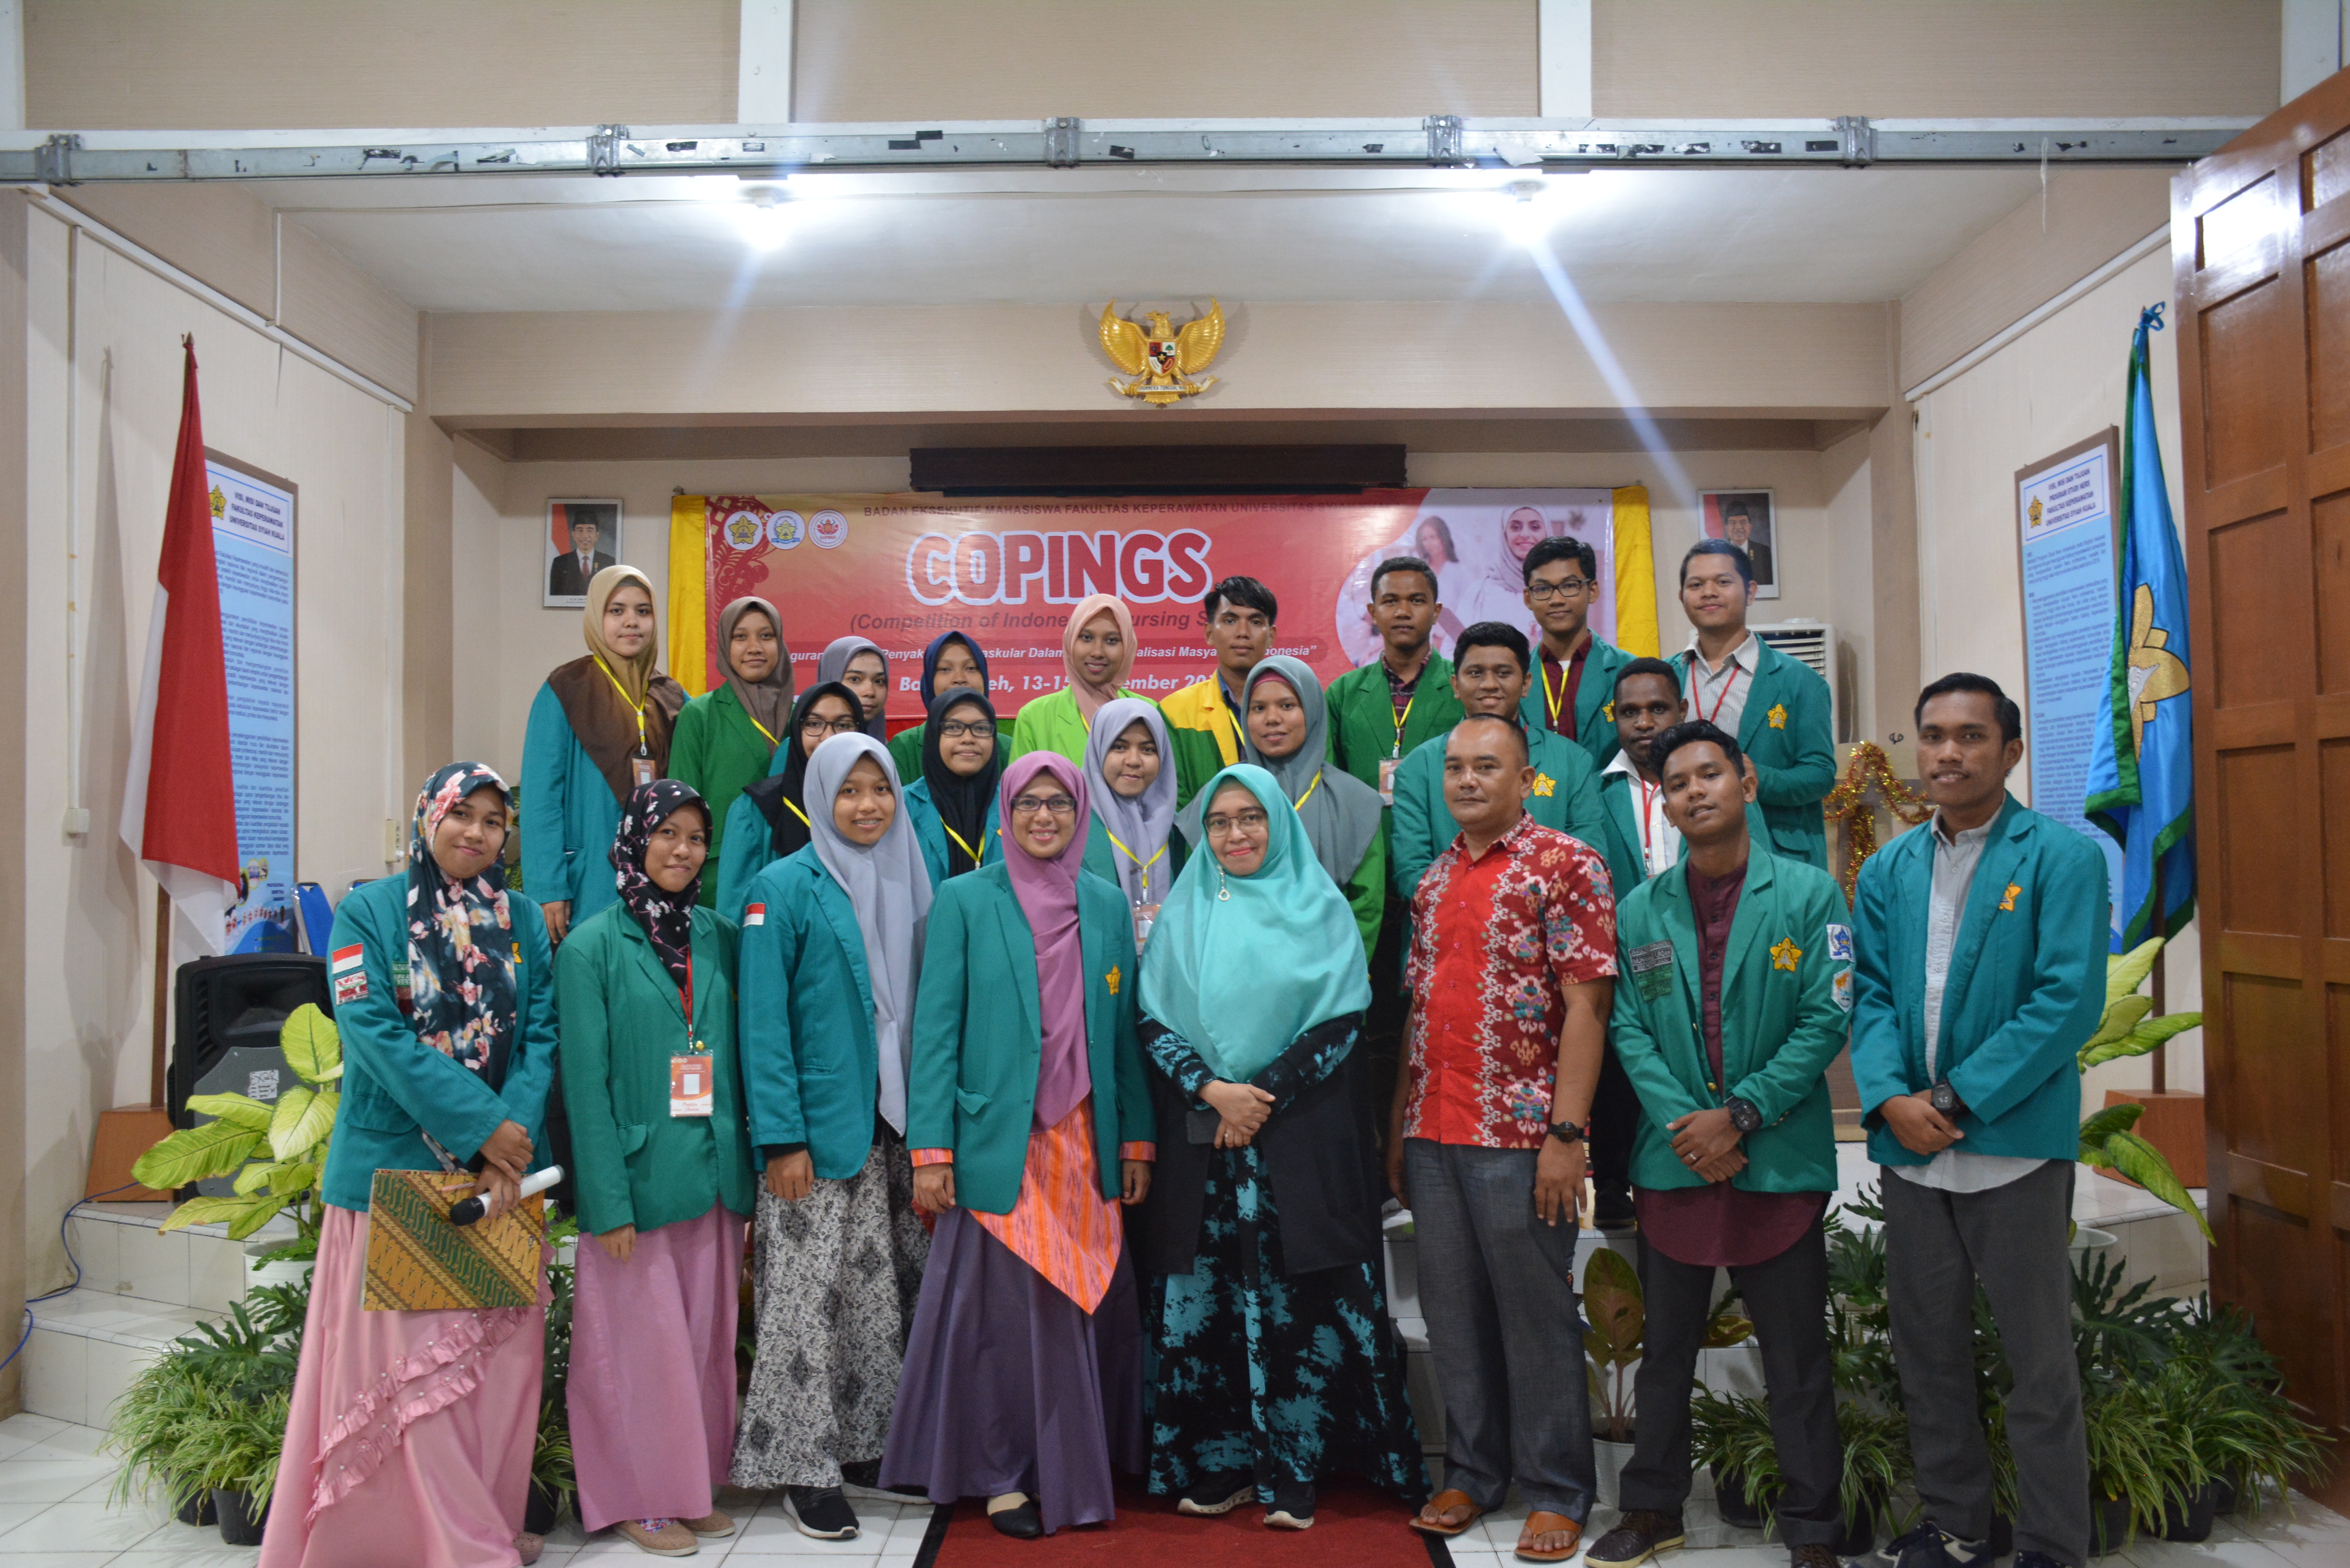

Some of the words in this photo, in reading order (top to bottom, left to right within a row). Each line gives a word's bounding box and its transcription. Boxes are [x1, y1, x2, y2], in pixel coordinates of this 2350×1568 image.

[863, 506, 907, 516] BADAN
[912, 505, 981, 515] EKSEKUTIF
[985, 504, 1062, 515] MAHASISWA
[1065, 504, 1129, 514] FAKULTAS
[1133, 503, 1227, 513] KEPERAWATAN
[1232, 502, 1314, 512] UNIVERSITAS
[906, 529, 1212, 606] COPINGS
[850, 613, 972, 632] (Competition
[979, 613, 999, 628] of
[1003, 612, 1068, 628] Indone
[1131, 611, 1190, 630] ursing
[1196, 610, 1207, 626] S
[790, 652, 824, 663] guran
[883, 649, 924, 661] Penyak
[982, 648, 1026, 658] askular
[1136, 647, 1176, 657] alisasi
[1178, 646, 1217, 659] Masya
[899, 677, 920, 691] Ba
[988, 675, 1015, 693] eh,
[1122, 674, 1179, 690] ember
[1184, 674, 1213, 688] 20
